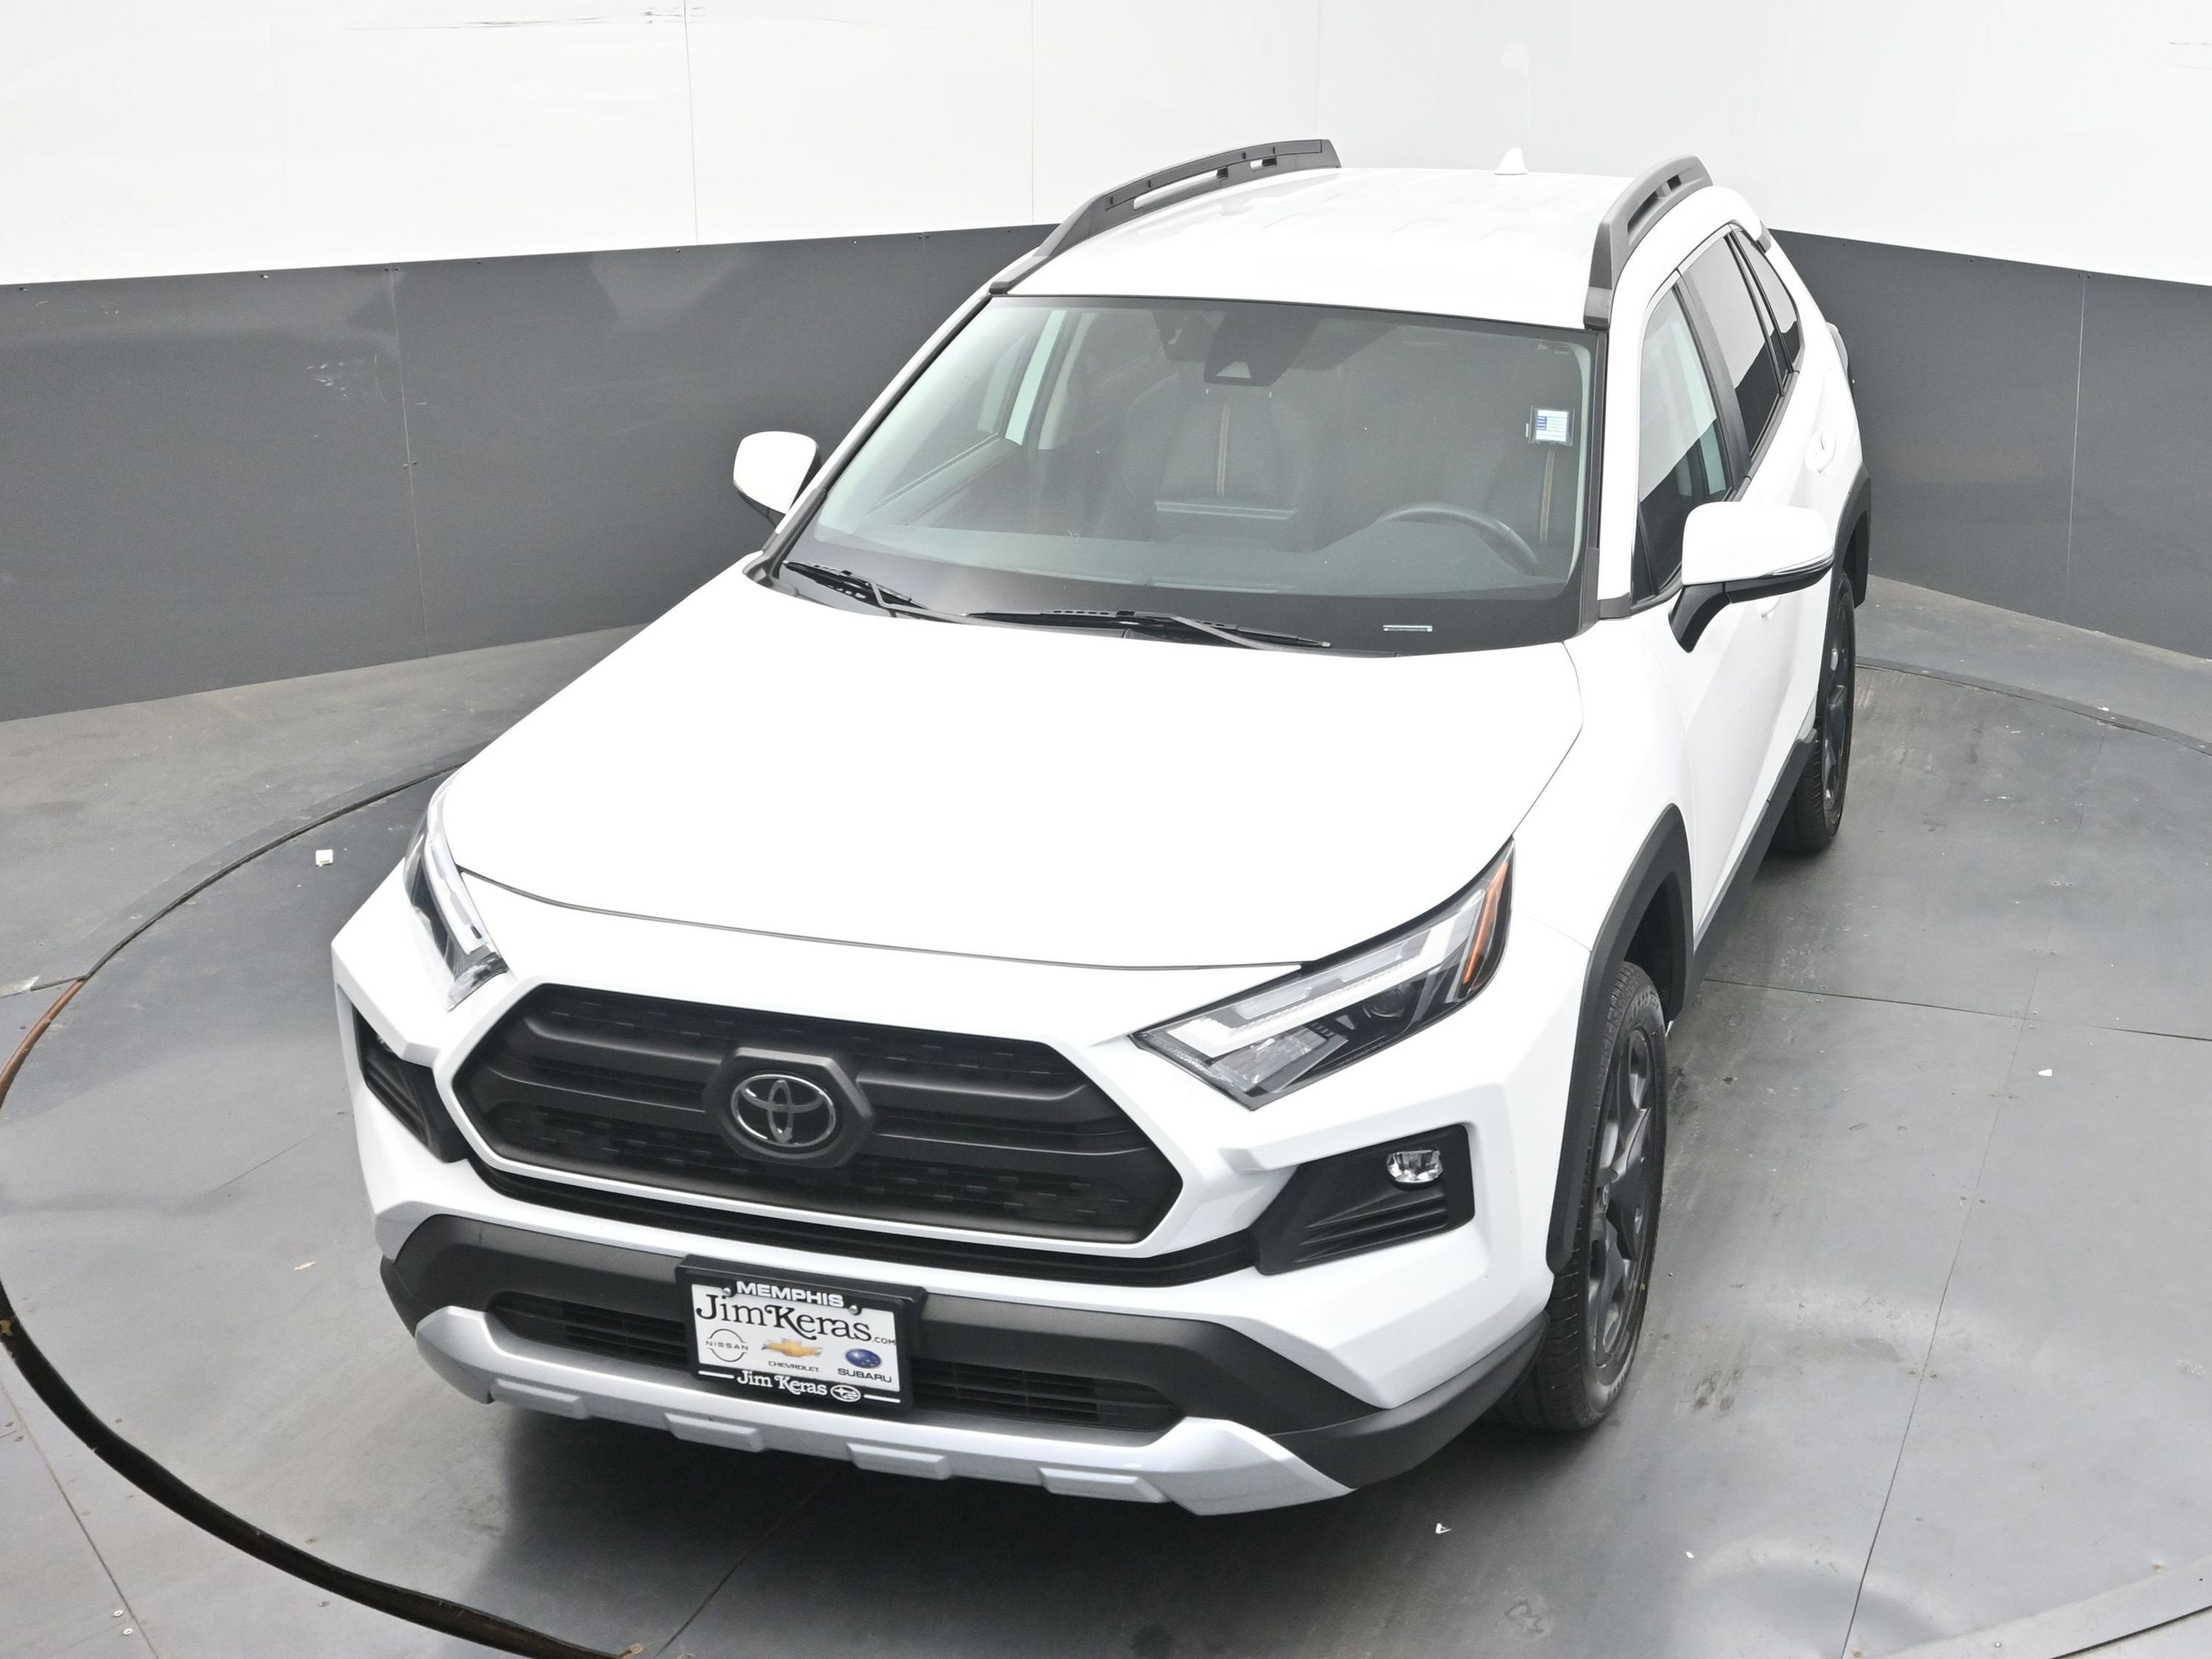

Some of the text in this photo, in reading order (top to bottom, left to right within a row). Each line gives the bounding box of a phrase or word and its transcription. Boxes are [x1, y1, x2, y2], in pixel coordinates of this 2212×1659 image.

[737, 1281, 844, 1307] MEMPHIS
[706, 1339, 749, 1351] NISSAN
[768, 1360, 819, 1372] CHEVROLET
[737, 1370, 828, 1395] Jim Keras
[838, 1368, 892, 1383] SUBARU
